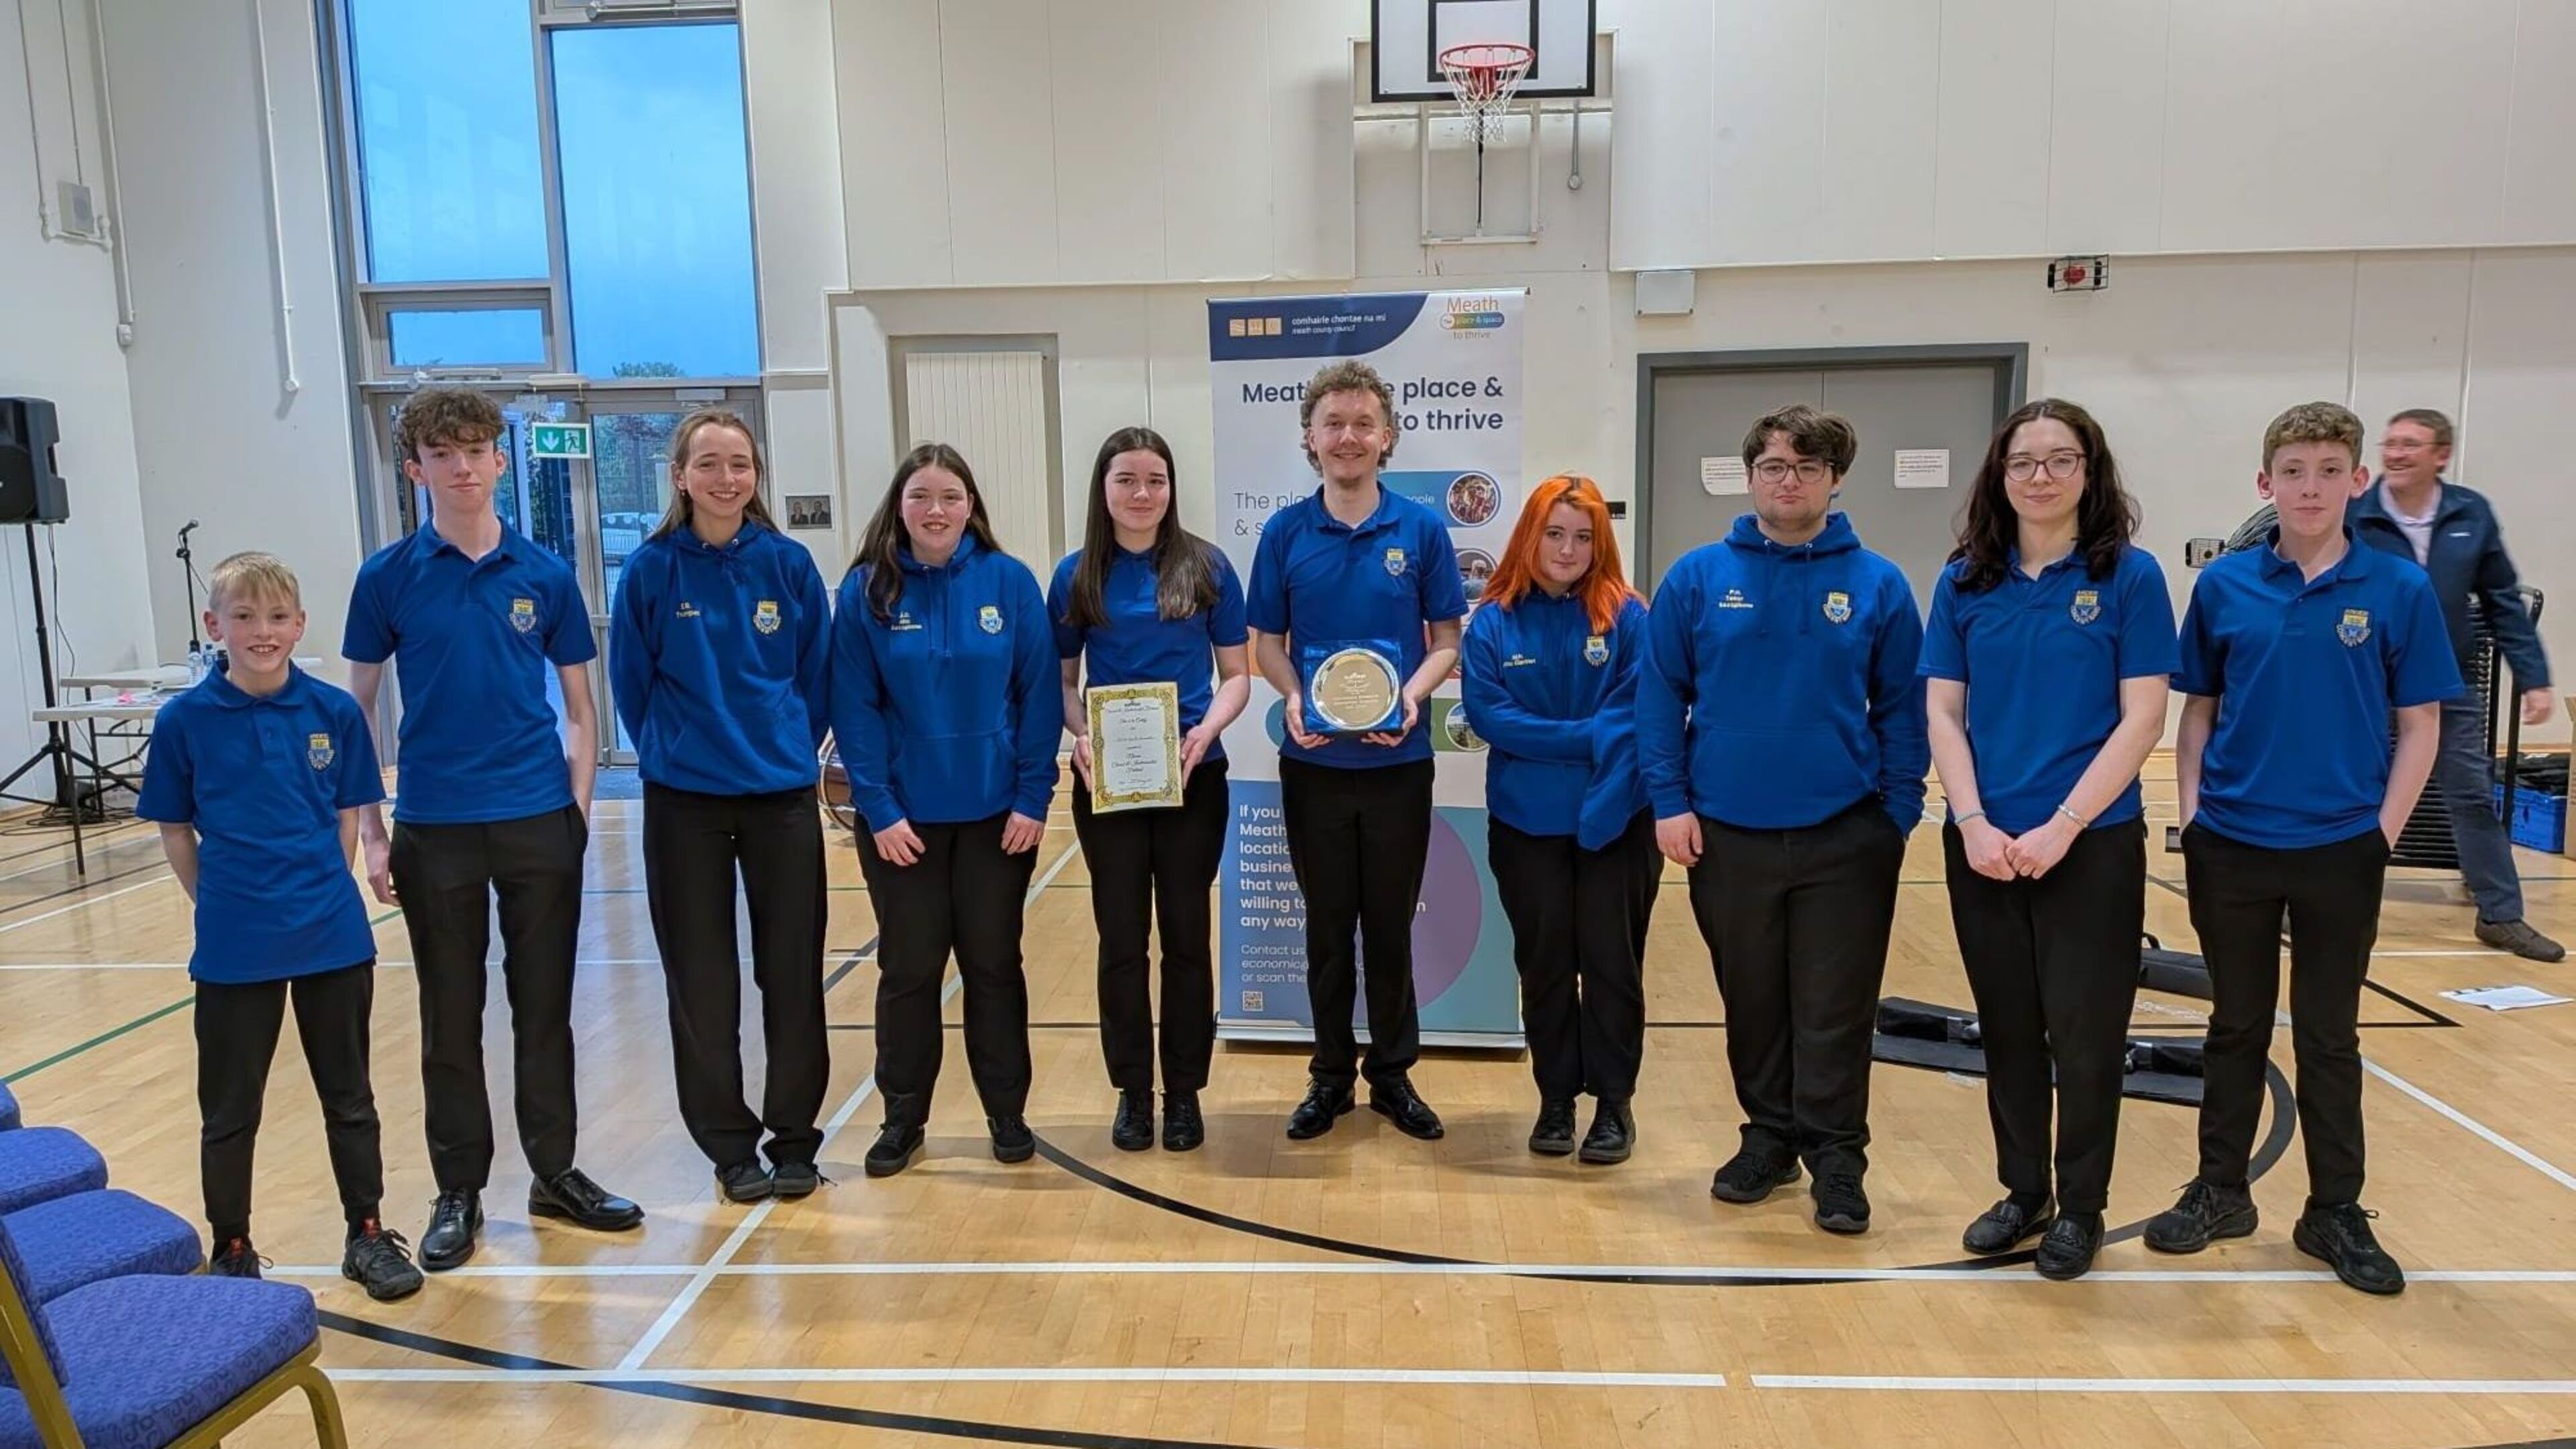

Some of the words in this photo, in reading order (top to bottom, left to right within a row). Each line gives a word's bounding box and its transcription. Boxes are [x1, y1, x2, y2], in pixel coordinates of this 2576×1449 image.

[1447, 295, 1499, 312] Meath
[1453, 331, 1463, 339] to
[1464, 329, 1491, 339] thrive
[1242, 381, 1308, 402] Meat
[1403, 377, 1477, 405] place
[1484, 376, 1503, 397] &
[1393, 411, 1419, 431] to
[1426, 408, 1504, 431] thrive
[1234, 491, 1270, 510] The
[1277, 490, 1307, 509] pla
[1234, 518, 1248, 536] &
[1240, 805, 1248, 817] If
[1252, 807, 1280, 822] you
[1240, 824, 1287, 836] Meath
[1240, 859, 1292, 873] busine
[1240, 877, 1273, 891] that
[1276, 881, 1299, 891] we
[1240, 896, 1290, 913] willing
[1241, 916, 1270, 931] any
[1275, 917, 1306, 931] way
[1241, 945, 1289, 955] Contact
[1242, 974, 1253, 983] or
[1257, 975, 1285, 983] scan
